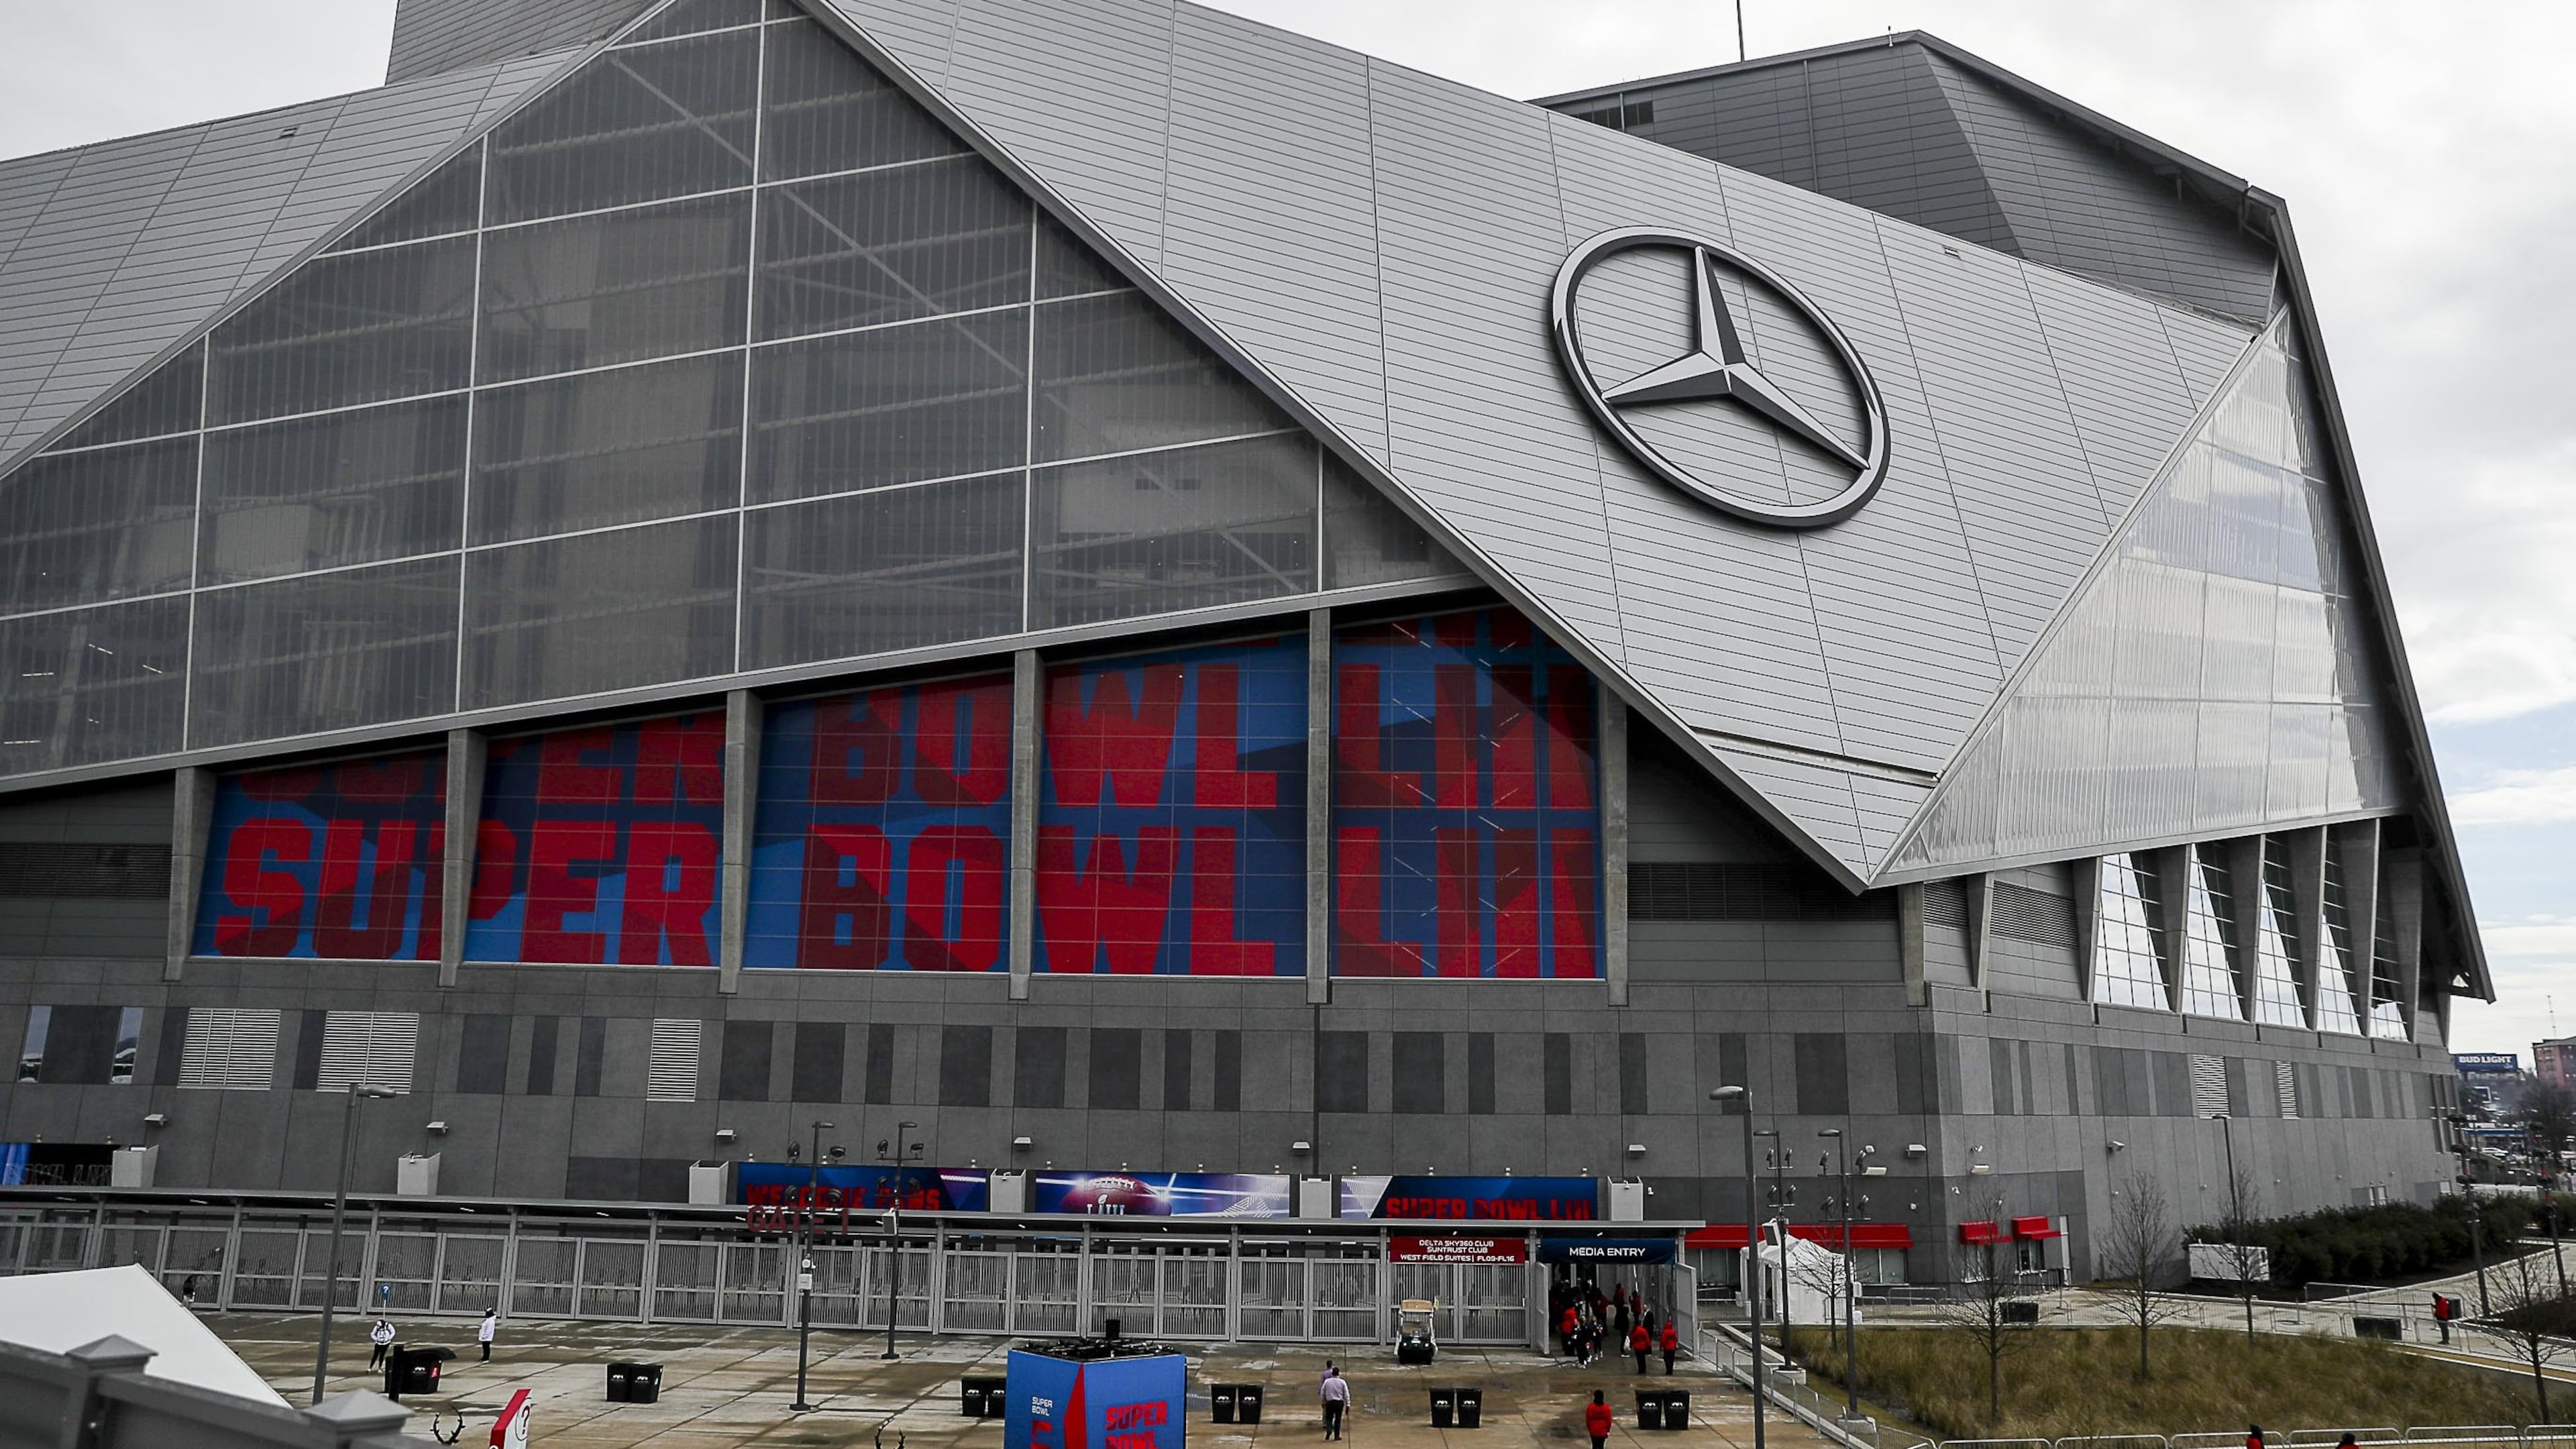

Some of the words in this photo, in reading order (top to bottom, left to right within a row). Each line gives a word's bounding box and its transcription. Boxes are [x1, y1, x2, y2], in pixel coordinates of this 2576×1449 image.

[215, 818, 721, 966] SUPER
[798, 824, 1275, 976] BOWL
[1338, 826, 1596, 977] LIII
[1569, 1247, 1605, 1256] MEDIA
[1607, 1248, 1646, 1256] ENTRY
[1032, 1397, 1053, 1408] SUPER
[1032, 1405, 1050, 1417] BOWL
[1106, 1401, 1168, 1431] SUPER
